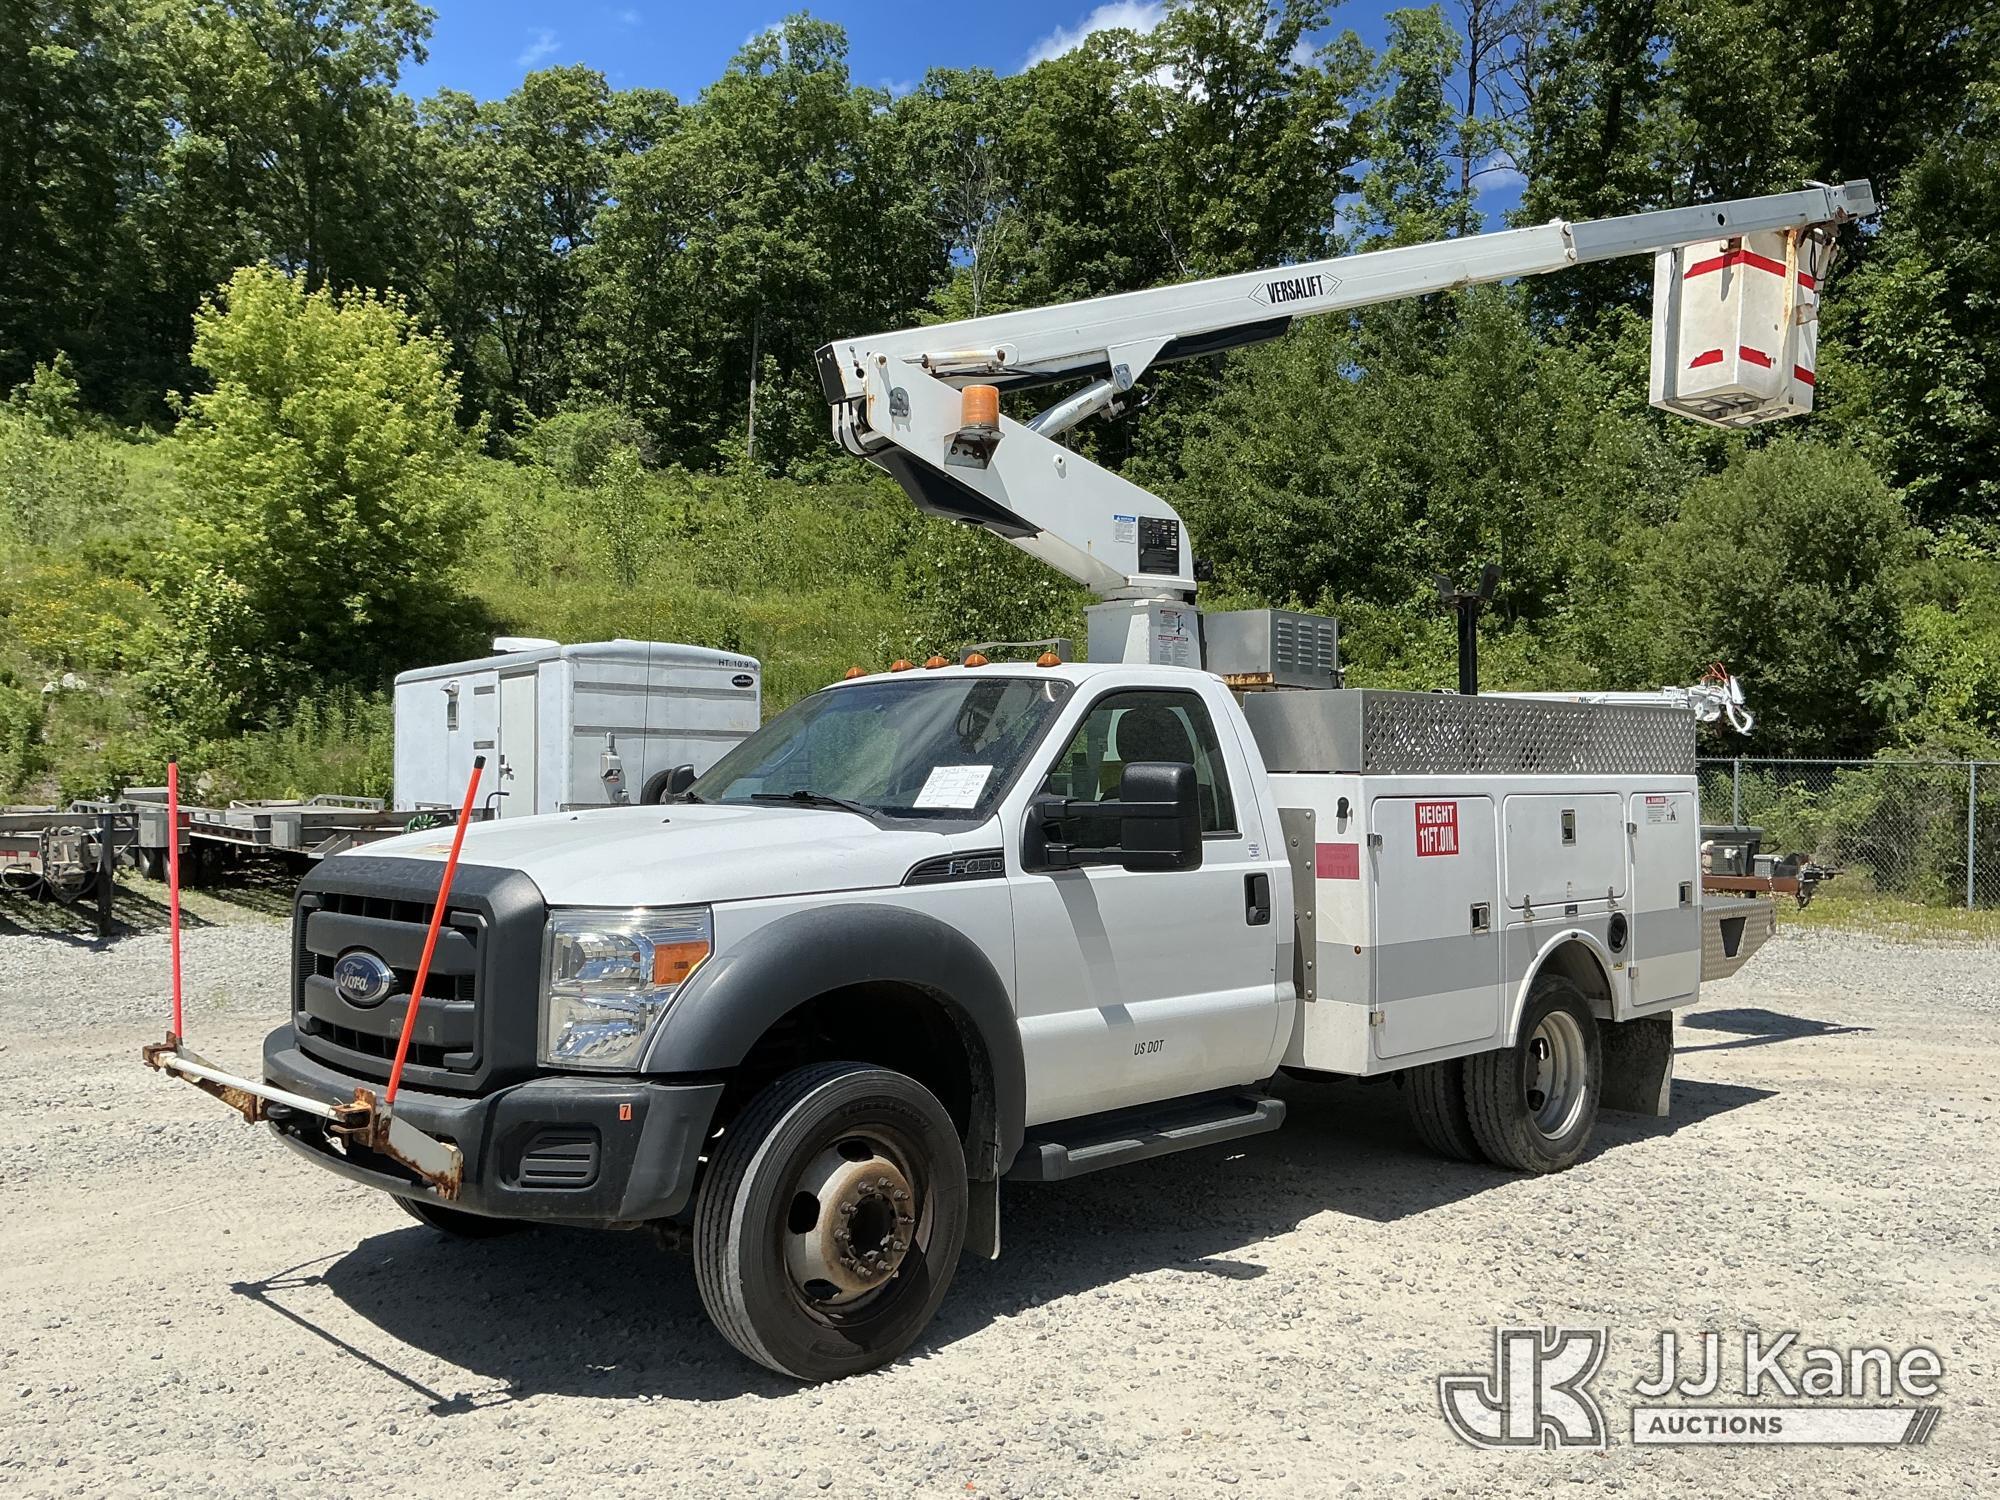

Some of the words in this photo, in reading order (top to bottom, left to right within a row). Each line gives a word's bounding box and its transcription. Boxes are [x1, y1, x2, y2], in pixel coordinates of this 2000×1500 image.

[1266, 275, 1324, 304] VERSALIFT
[1420, 805, 1454, 824] HEIGHT
[340, 961, 369, 992] Ford
[1134, 1042, 1146, 1056] US
[1147, 1039, 1165, 1053] DOT
[621, 1104, 630, 1119] 7
